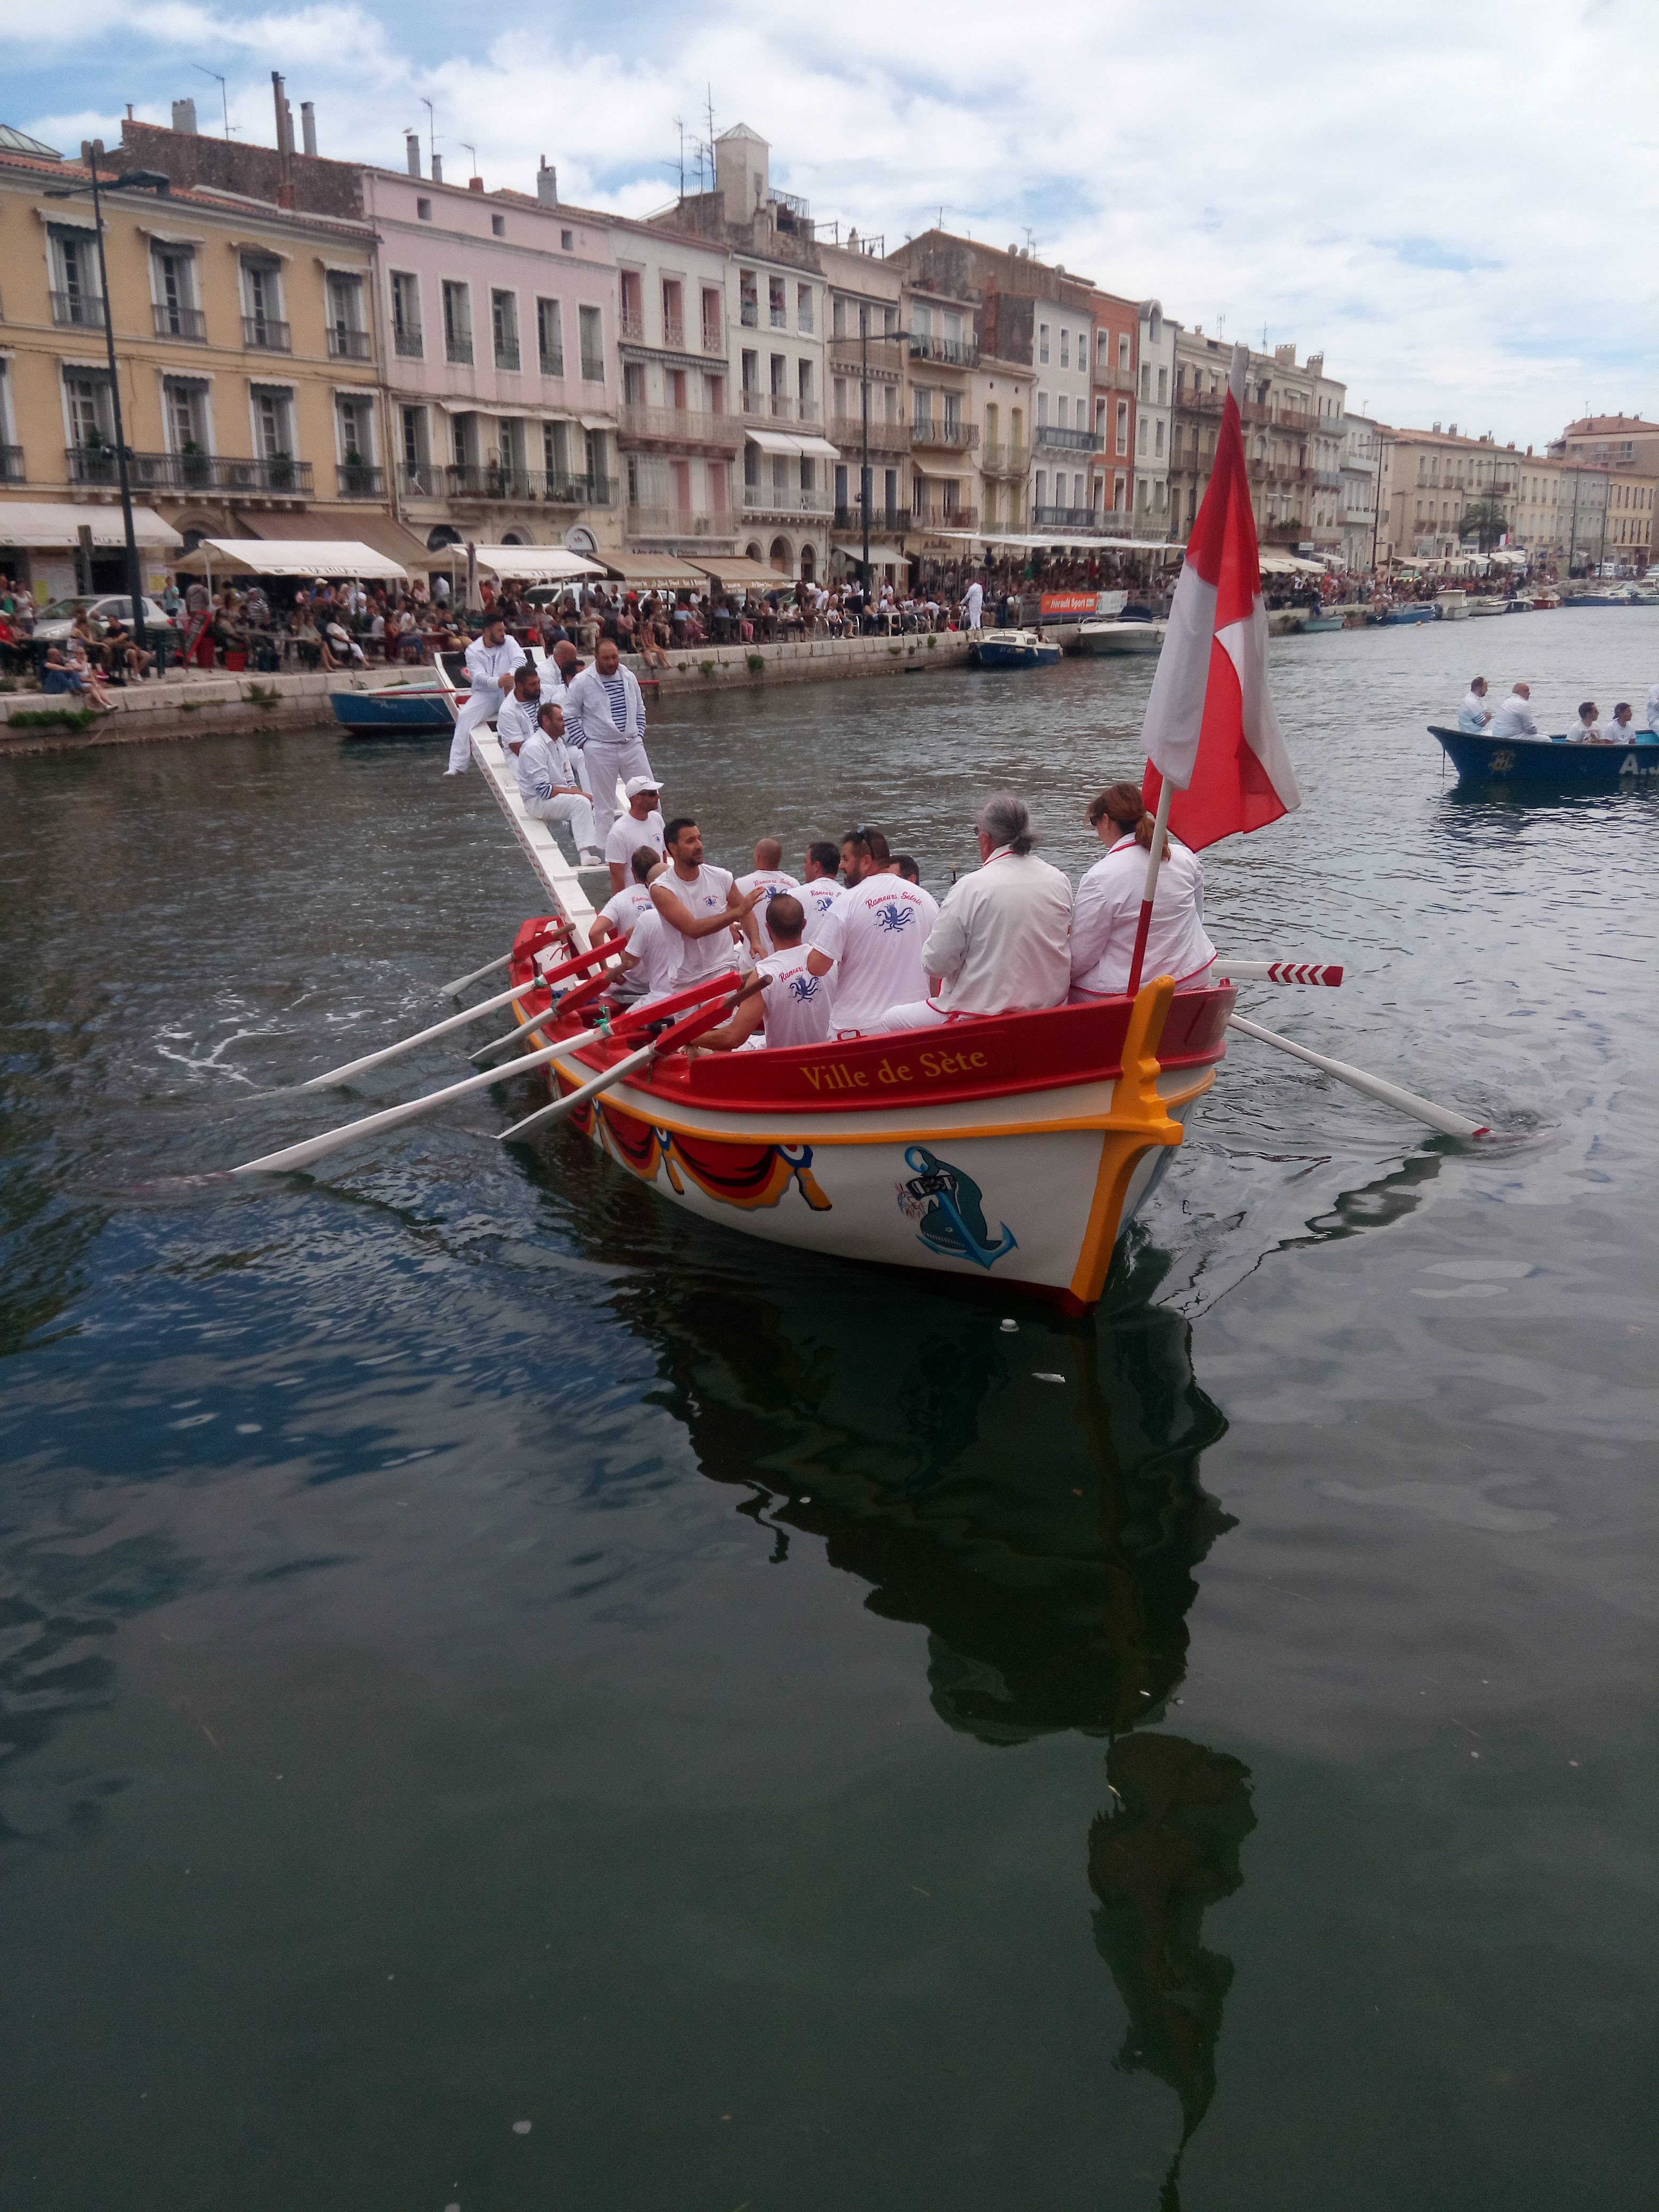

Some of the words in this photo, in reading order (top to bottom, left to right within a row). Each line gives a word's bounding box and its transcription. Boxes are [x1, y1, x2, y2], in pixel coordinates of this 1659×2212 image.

[1050, 597, 1071, 609] Hérault
[1071, 597, 1086, 610] Sport
[865, 894, 898, 909] Rameurs
[779, 966, 803, 982] Rameurs
[799, 1063, 869, 1091] Ville
[877, 1059, 914, 1084] de
[919, 1051, 988, 1077] Sète
